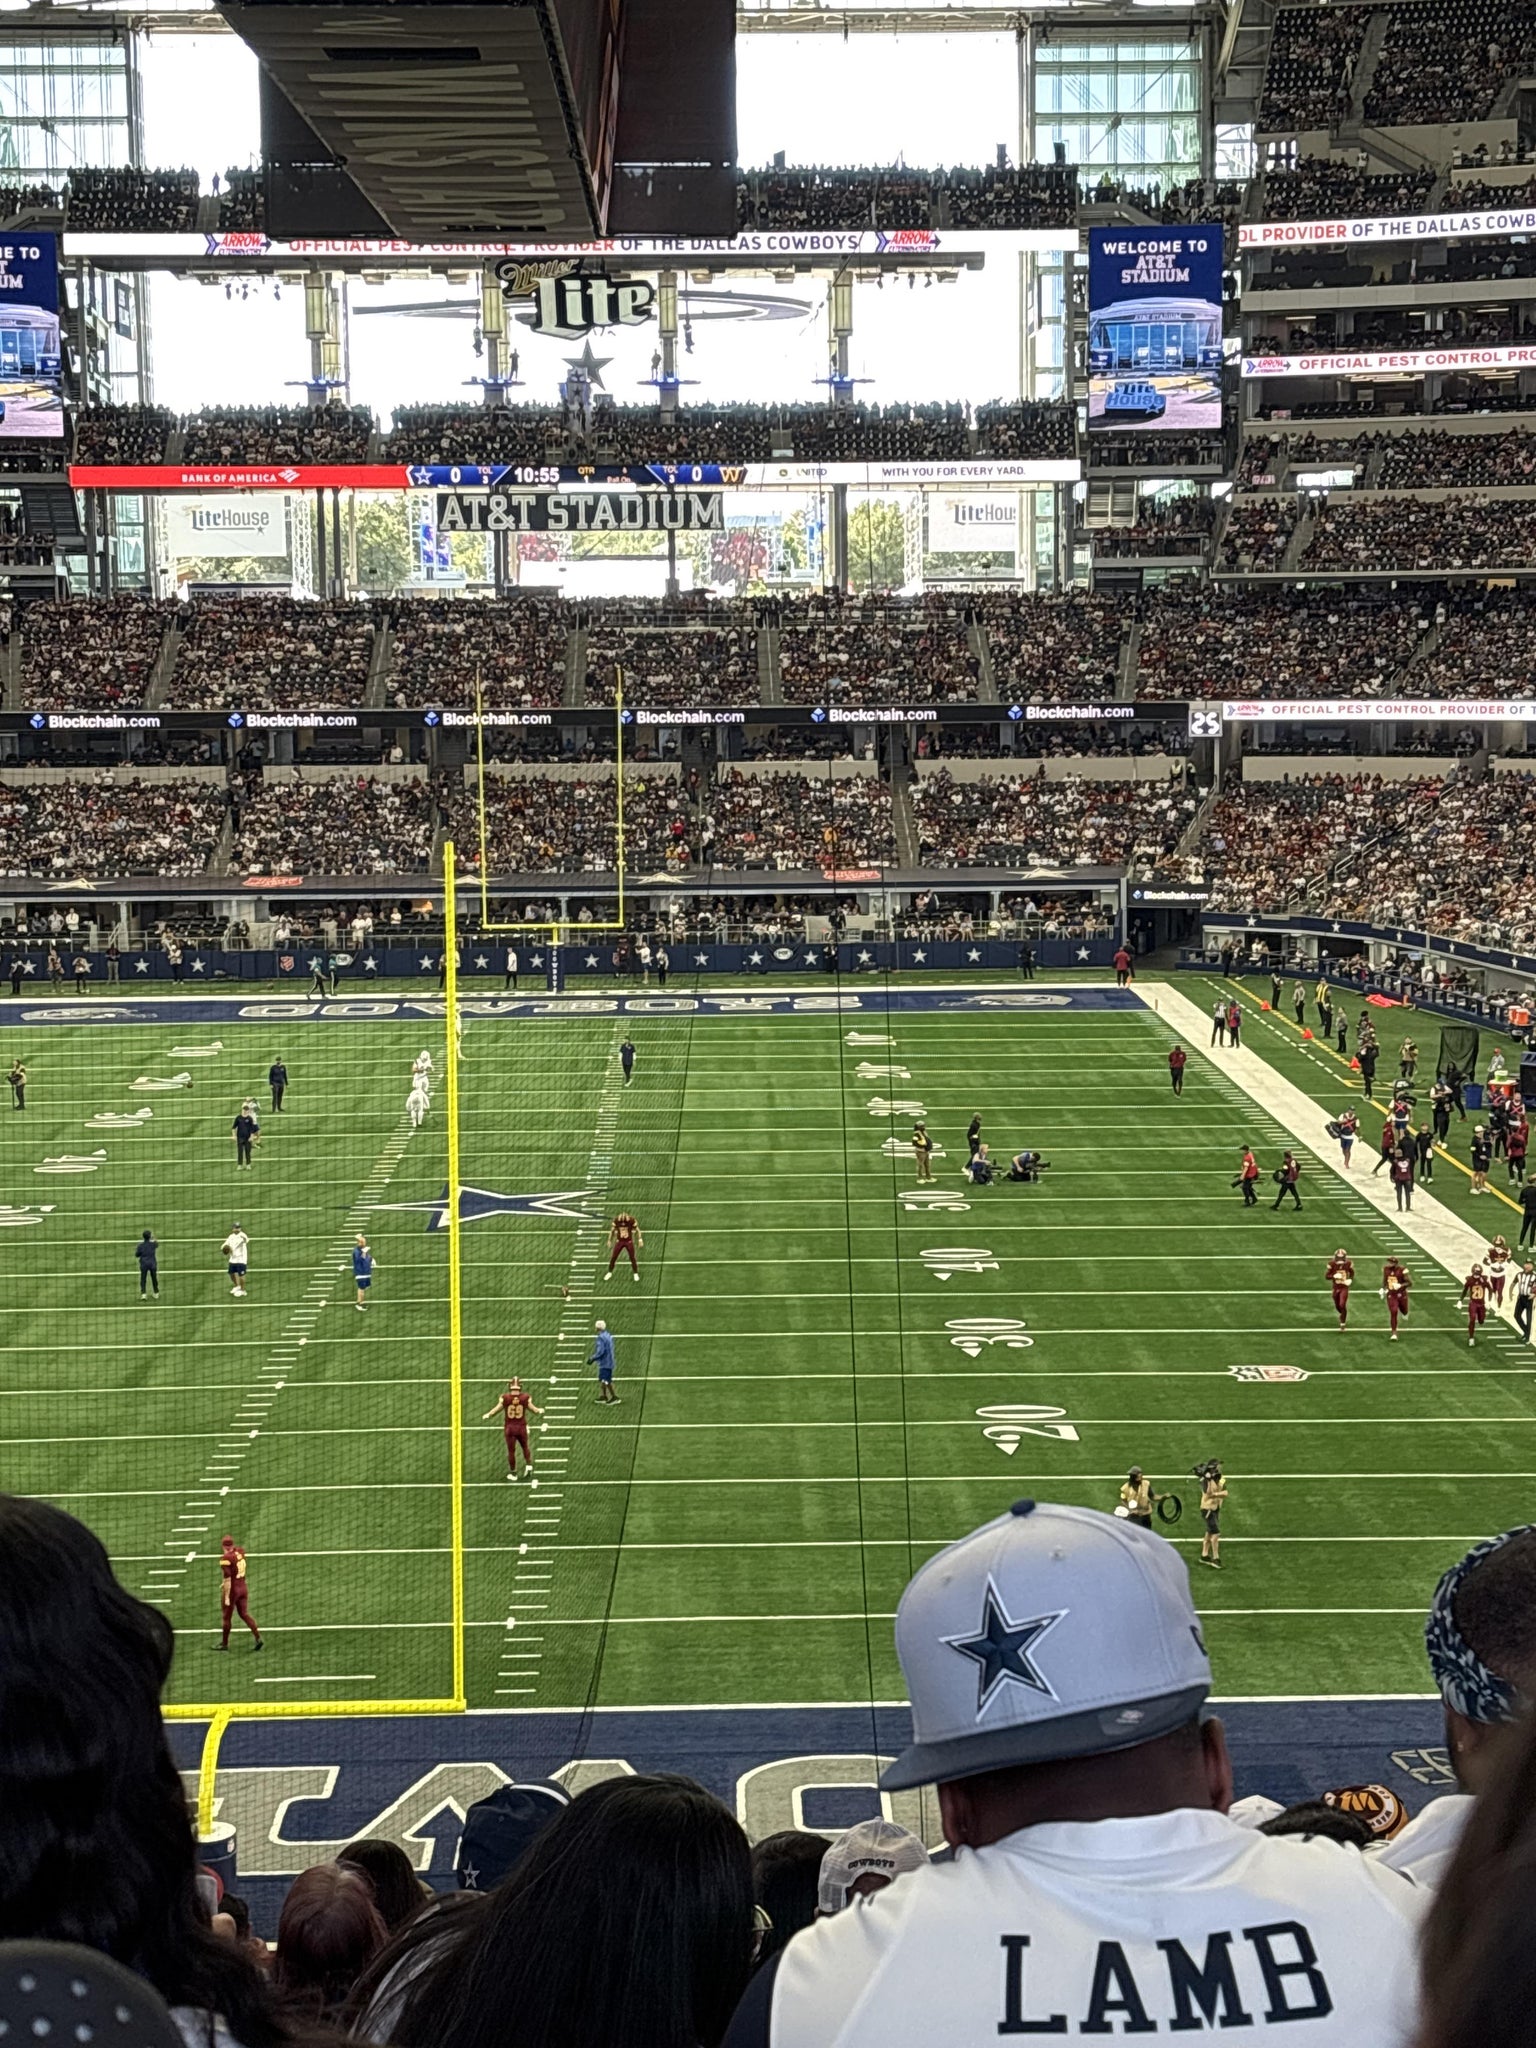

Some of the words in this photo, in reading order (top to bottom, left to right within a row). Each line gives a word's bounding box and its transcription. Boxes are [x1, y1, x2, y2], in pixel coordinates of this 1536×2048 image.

[308, 64, 566, 224] WINSTAR
[1263, 225, 1347, 241] PROVIDER
[1352, 223, 1374, 237] OF
[1379, 221, 1412, 236] THE
[1417, 217, 1481, 233] DALLAS
[221, 233, 262, 247] ARROW
[289, 239, 374, 251] OFFICIAL
[620, 239, 643, 251] OF
[691, 236, 762, 250] DALLAS
[767, 235, 858, 250] COWBOYS
[891, 231, 931, 244] ARROW
[19, 246, 41, 259] TO
[1103, 240, 1183, 255] WELCOME
[1188, 239, 1208, 252] TO
[1136, 255, 1176, 269] AT&T
[501, 258, 580, 296] Miller
[1121, 268, 1190, 284] STADIUM
[533, 277, 652, 340] Lite
[1300, 357, 1373, 371] OFFICIAL
[1378, 355, 1420, 368] PEST
[1425, 352, 1503, 365] CONTROL
[181, 474, 211, 483] BANK
[213, 474, 226, 483] OF
[228, 474, 277, 483] AMERICA
[450, 467, 461, 483] 0
[514, 467, 560, 483] 10:55
[692, 467, 702, 482] 0
[882, 467, 909, 476] WITH
[912, 467, 933, 476] YOU
[937, 467, 957, 475] FOR
[960, 467, 993, 475] EVERY
[997, 466, 1026, 475] YARD.
[439, 494, 536, 531] AT&T
[547, 493, 724, 530] STADIUM
[637, 710, 745, 724] Blockchain.com
[829, 708, 937, 721] Blockchain.com
[1027, 705, 1134, 719] Blockchain.com
[1272, 705, 1333, 714] OFFICIAL
[1338, 705, 1371, 714] PEST
[1376, 705, 1435, 714] CONTROL
[1440, 705, 1505, 714] PROVIDER
[1510, 705, 1525, 714] OF
[49, 715, 160, 728] Blockchain.com
[247, 713, 357, 727] Blockchain.com
[945, 1318, 1035, 1348] 30
[507, 1404, 524, 1419] 69
[975, 1404, 1080, 1441] 20
[848, 1858, 895, 1869] COWBOYS
[998, 1921, 1334, 2034] LAMB
